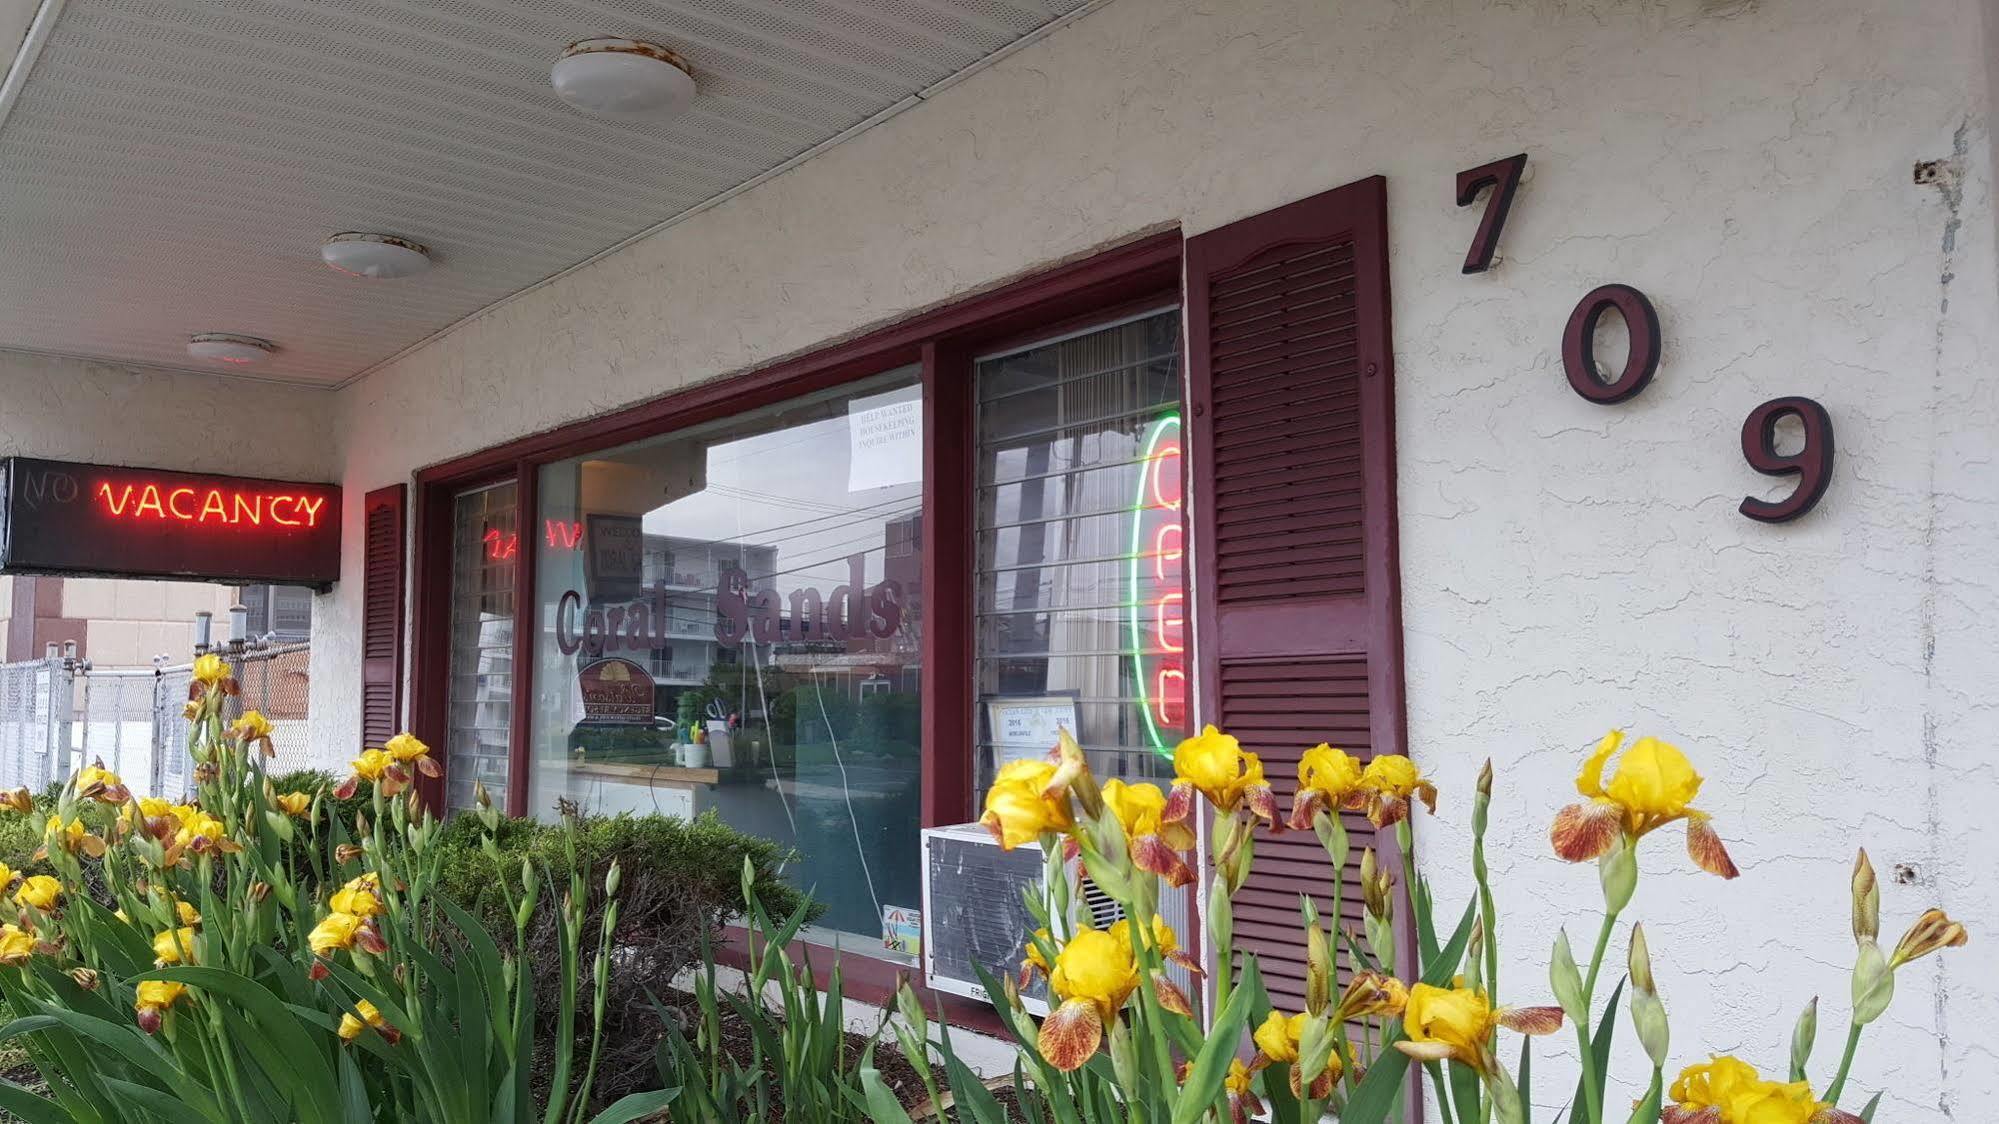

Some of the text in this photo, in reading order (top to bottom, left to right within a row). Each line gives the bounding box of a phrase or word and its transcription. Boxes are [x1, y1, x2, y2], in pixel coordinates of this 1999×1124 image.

[1456, 153, 1528, 274] 7
[1562, 283, 1661, 406] 0
[24, 467, 324, 527] NO VACANCY
[1739, 395, 1835, 523] 9
[556, 551, 904, 656] Coral Sands
